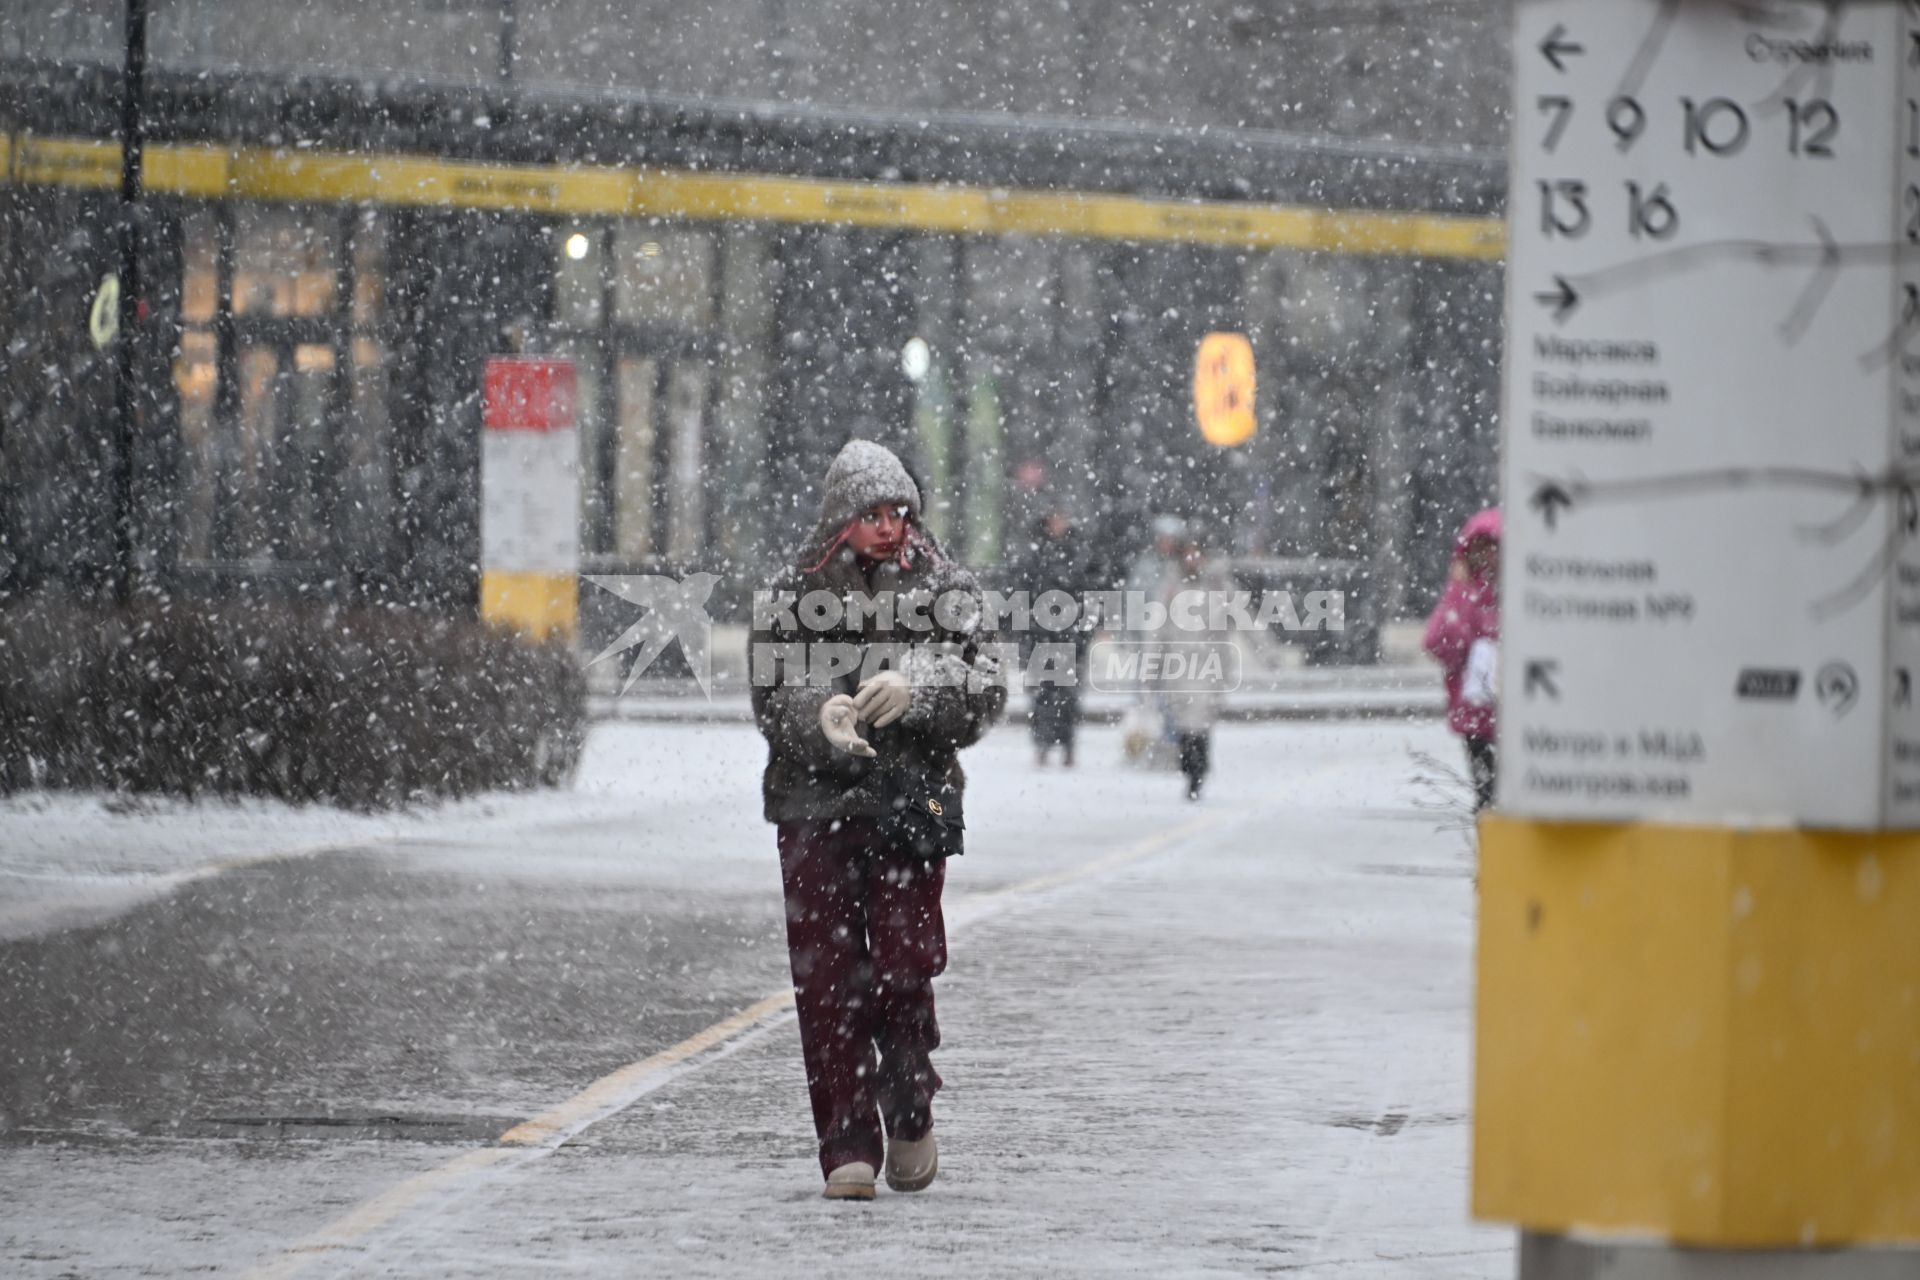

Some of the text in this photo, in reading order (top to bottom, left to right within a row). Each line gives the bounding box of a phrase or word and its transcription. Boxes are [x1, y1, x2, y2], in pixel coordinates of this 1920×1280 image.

[1537, 95, 1840, 158] 7 9 10 12
[1536, 179, 1679, 240] 13 16
